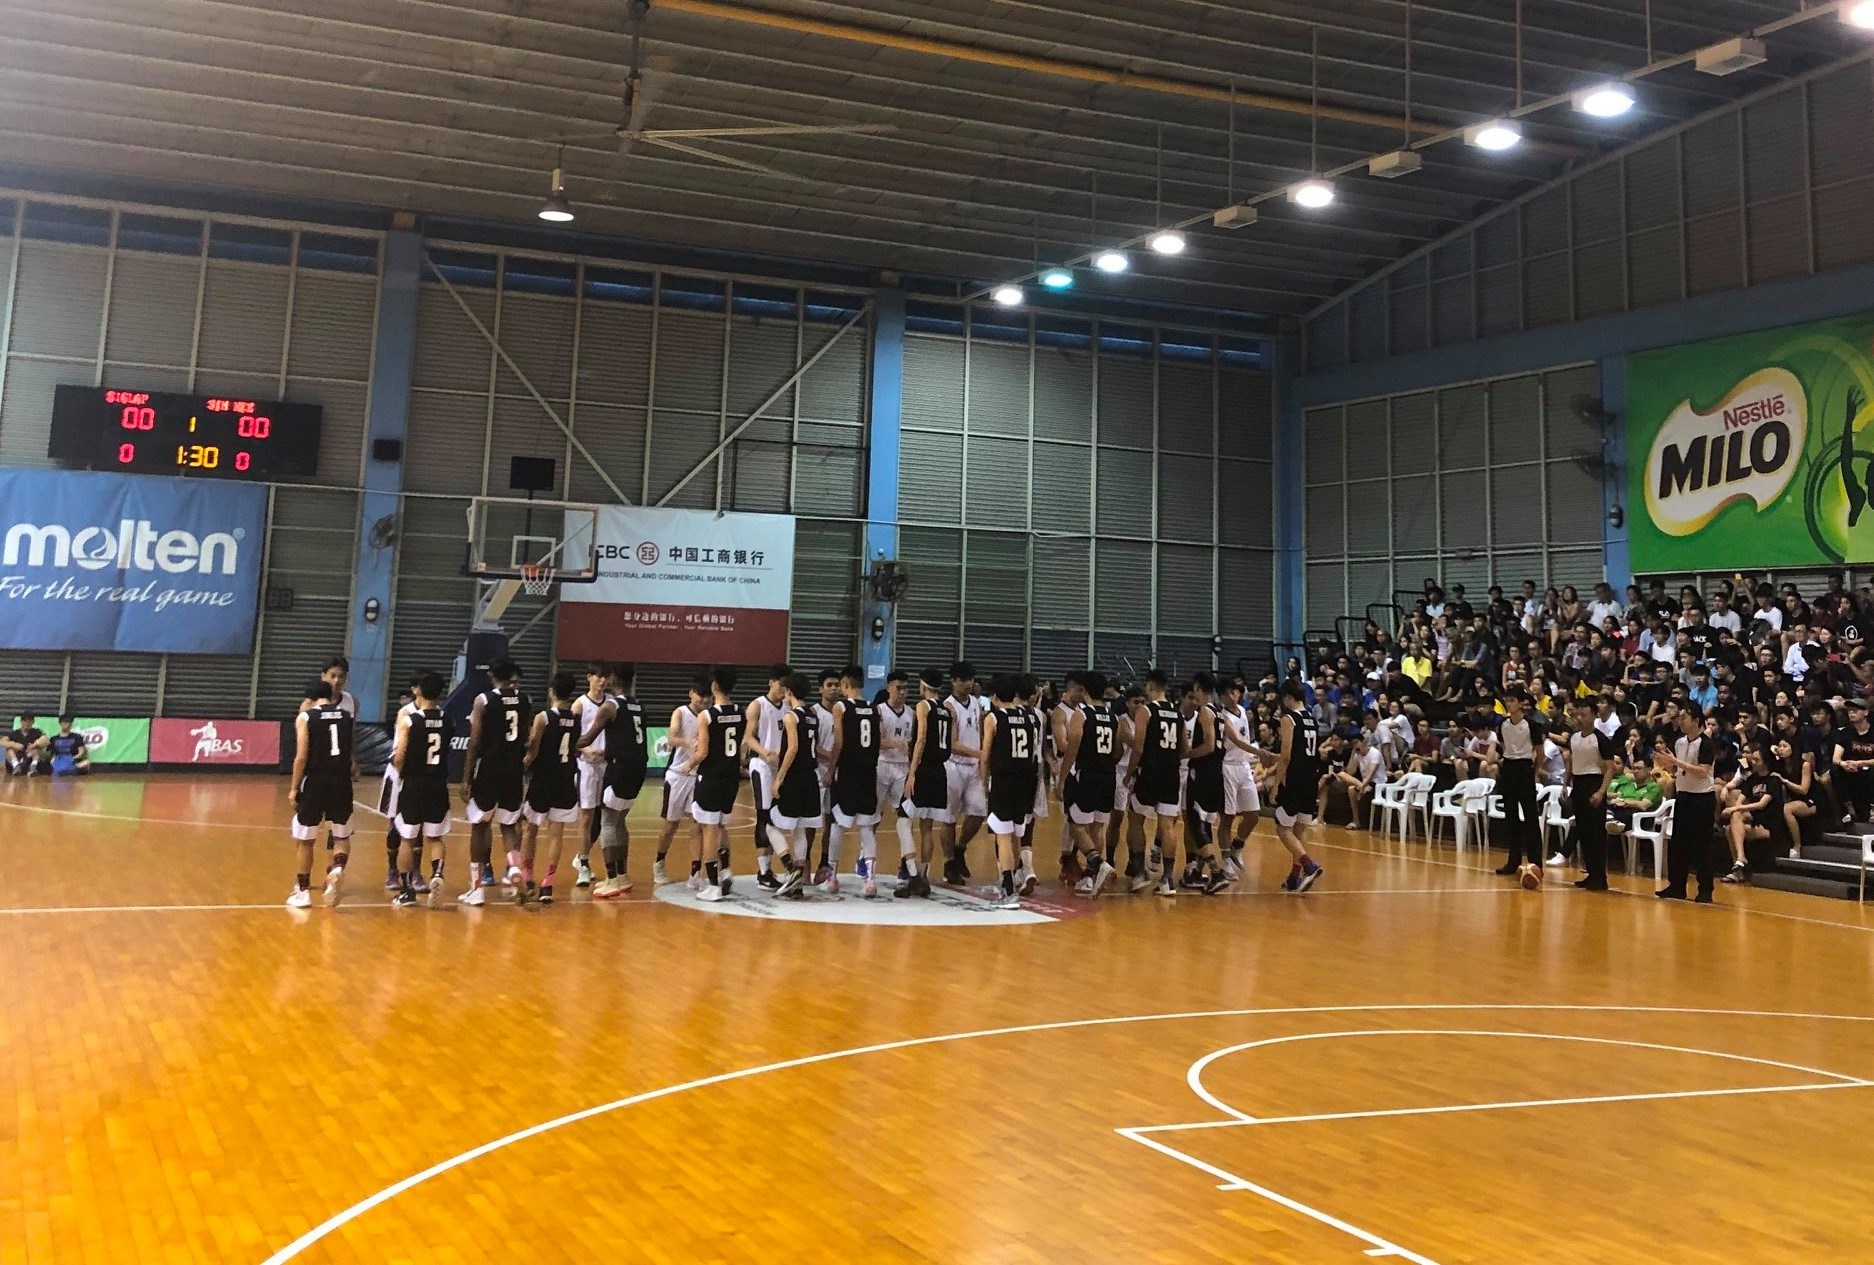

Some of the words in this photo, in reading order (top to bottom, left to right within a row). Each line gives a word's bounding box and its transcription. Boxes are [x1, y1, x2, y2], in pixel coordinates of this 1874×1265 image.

[121, 406, 155, 430] 00
[189, 416, 197, 432] 1
[238, 416, 270, 438] 00
[119, 443, 134, 463] 0
[177, 445, 219, 468] 1:30
[235, 452, 250, 470] 0
[1659, 420, 1791, 500] MILO
[3, 519, 238, 575] molten
[669, 546, 764, 566] 中国工商银行
[597, 571, 640, 579] NDUSTRIAL
[658, 573, 704, 582] COMMERCIAL
[707, 575, 726, 583] BANK
[0, 576, 41, 599] For
[43, 576, 93, 601] the
[94, 579, 158, 602] real
[155, 588, 236, 612] game
[505, 710, 518, 742] 3
[633, 716, 644, 744] 5
[860, 719, 871, 747] 8
[1096, 725, 1113, 754] 23
[1160, 721, 1177, 749] 34
[329, 724, 340, 757] 1
[427, 733, 441, 765] 2
[559, 732, 571, 763] 4
[725, 727, 737, 757] 6
[808, 729, 816, 758] 7
[1011, 728, 1028, 758] 12
